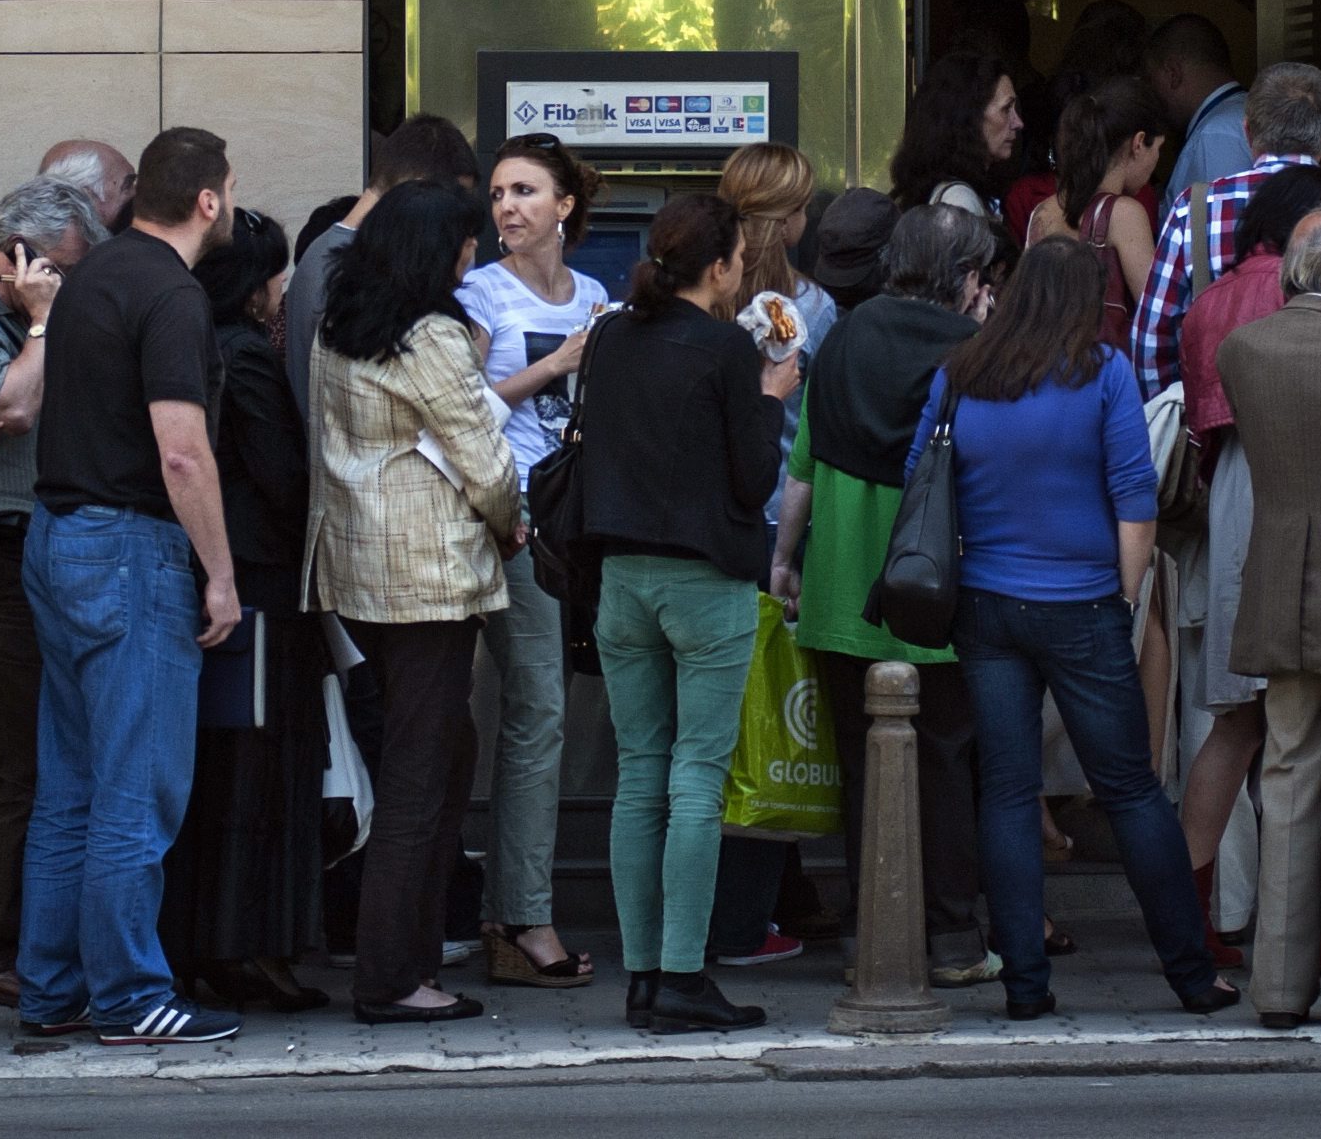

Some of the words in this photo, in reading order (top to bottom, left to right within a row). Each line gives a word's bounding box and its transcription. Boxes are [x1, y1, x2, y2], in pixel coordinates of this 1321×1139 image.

[543, 103, 617, 121] Fibank
[629, 118, 652, 127] VISA
[658, 118, 681, 127] VISA
[768, 760, 843, 787] GLOBUL
